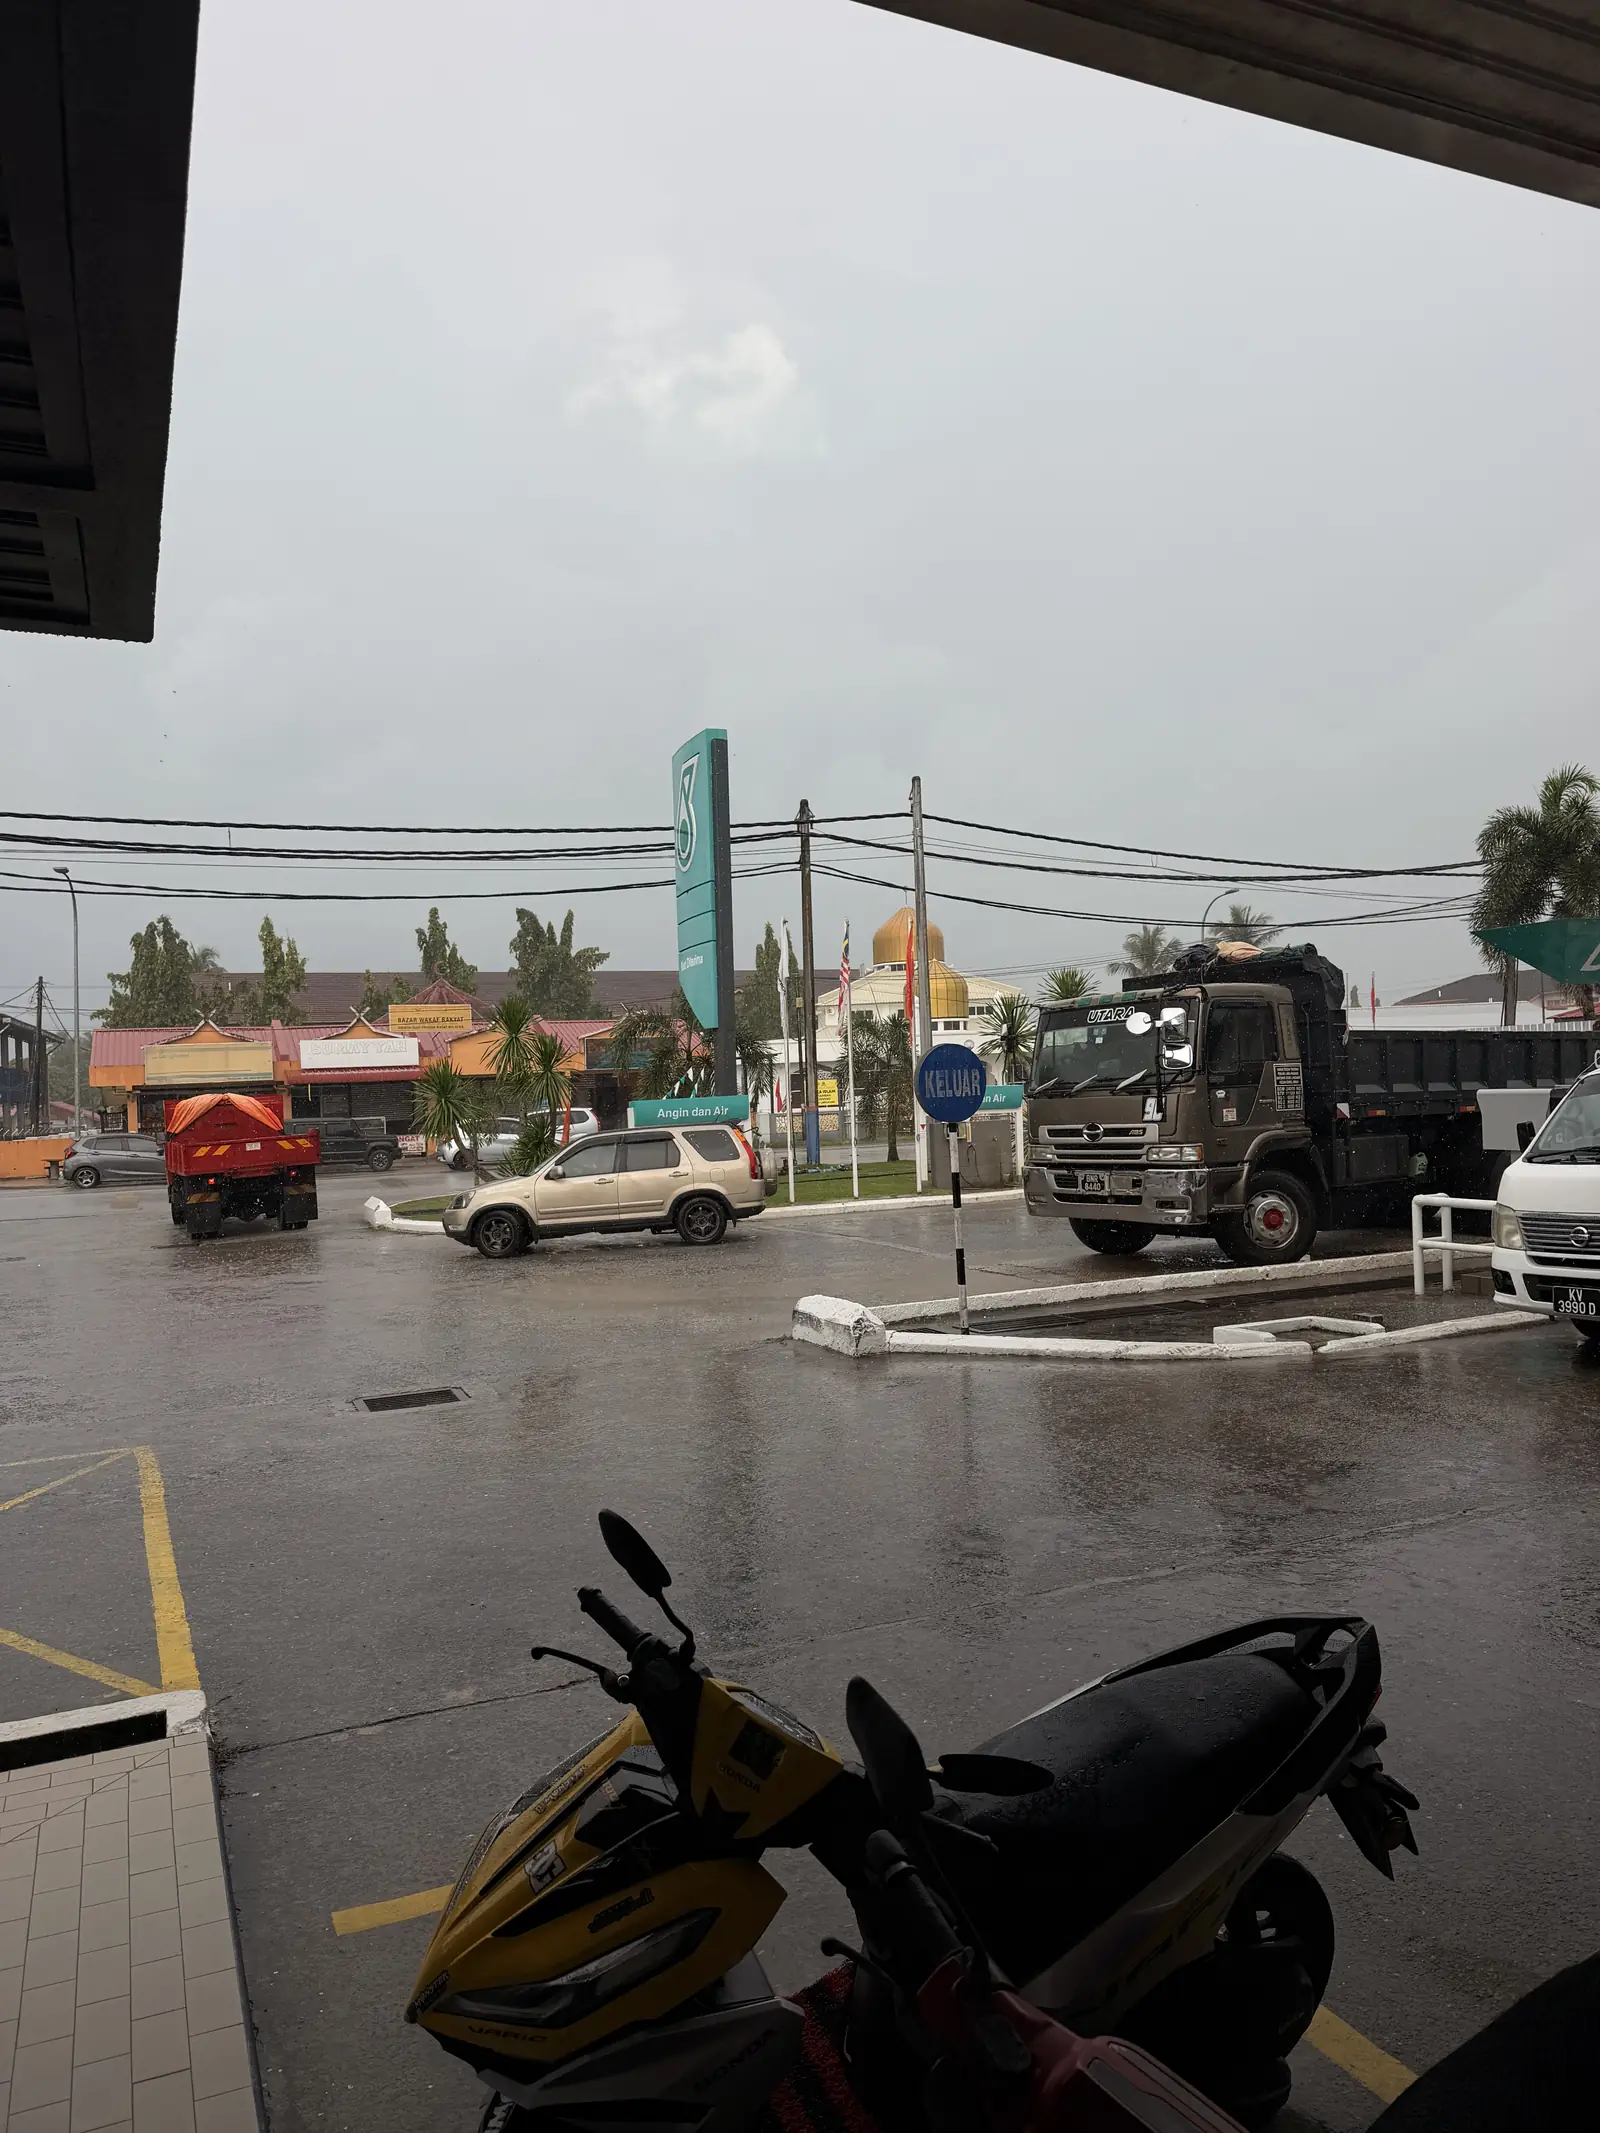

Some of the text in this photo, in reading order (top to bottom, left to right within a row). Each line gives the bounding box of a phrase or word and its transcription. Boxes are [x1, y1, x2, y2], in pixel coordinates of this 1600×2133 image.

[1088, 1006, 1136, 1023] UTARA
[925, 1069, 981, 1098] KELUAR
[992, 1093, 1006, 1103] Air
[657, 1105, 728, 1120] Angin dan Air
[1084, 1182, 1101, 1191] 8440
[1568, 1288, 1583, 1302] KV
[1558, 1300, 1596, 1315] 3990 D
[468, 2025, 548, 2042] VARIO
